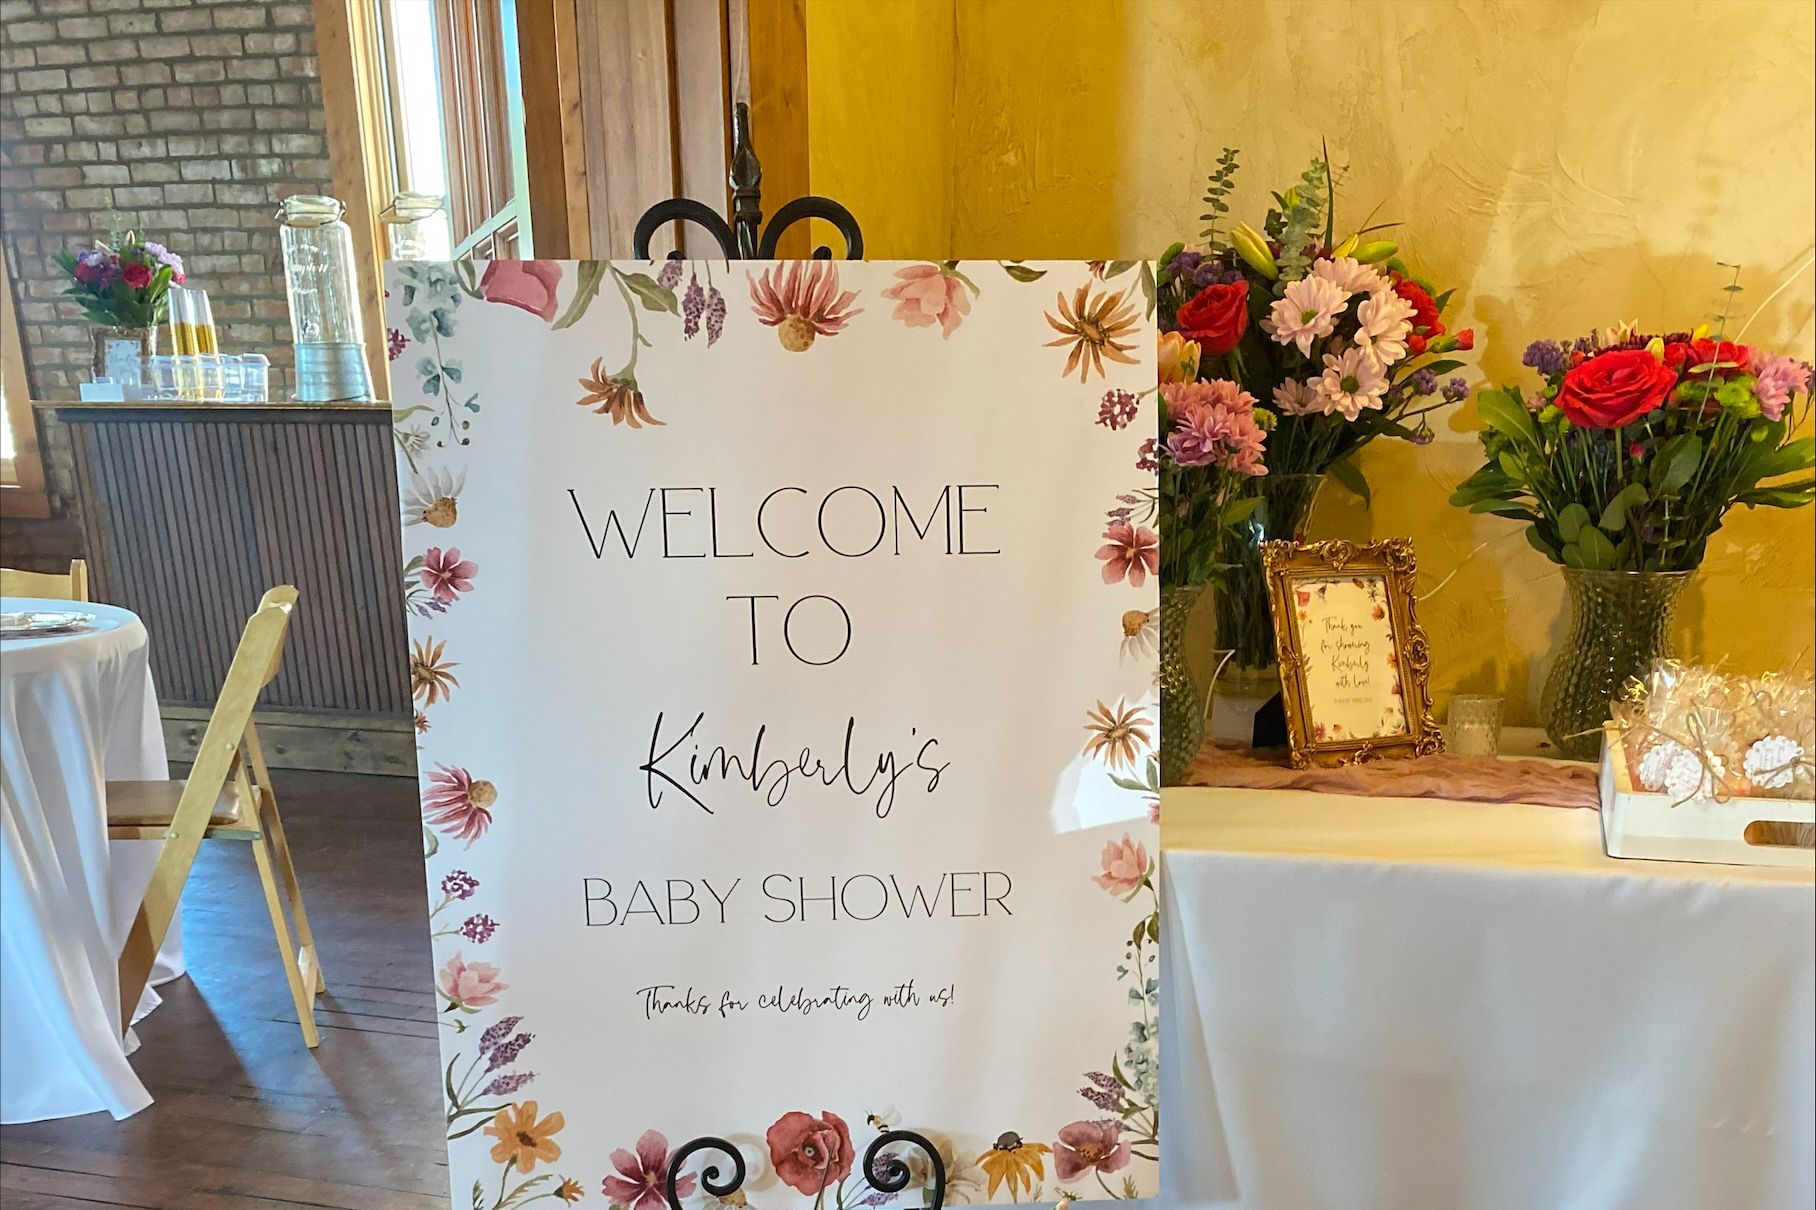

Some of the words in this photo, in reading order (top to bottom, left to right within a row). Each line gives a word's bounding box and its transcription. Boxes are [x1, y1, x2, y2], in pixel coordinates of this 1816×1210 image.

[566, 484, 1001, 559] WELCOME
[726, 594, 852, 666] TO
[1321, 616, 1348, 634] Thank
[638, 711, 951, 819] Kimberly's
[582, 877, 742, 927] BABY
[761, 871, 1014, 924] SHOWER
[636, 985, 712, 1021] Thanks
[718, 990, 749, 1019] for
[758, 985, 875, 1021] celebrating
[883, 979, 921, 1008] with
[929, 984, 955, 1008] us!
